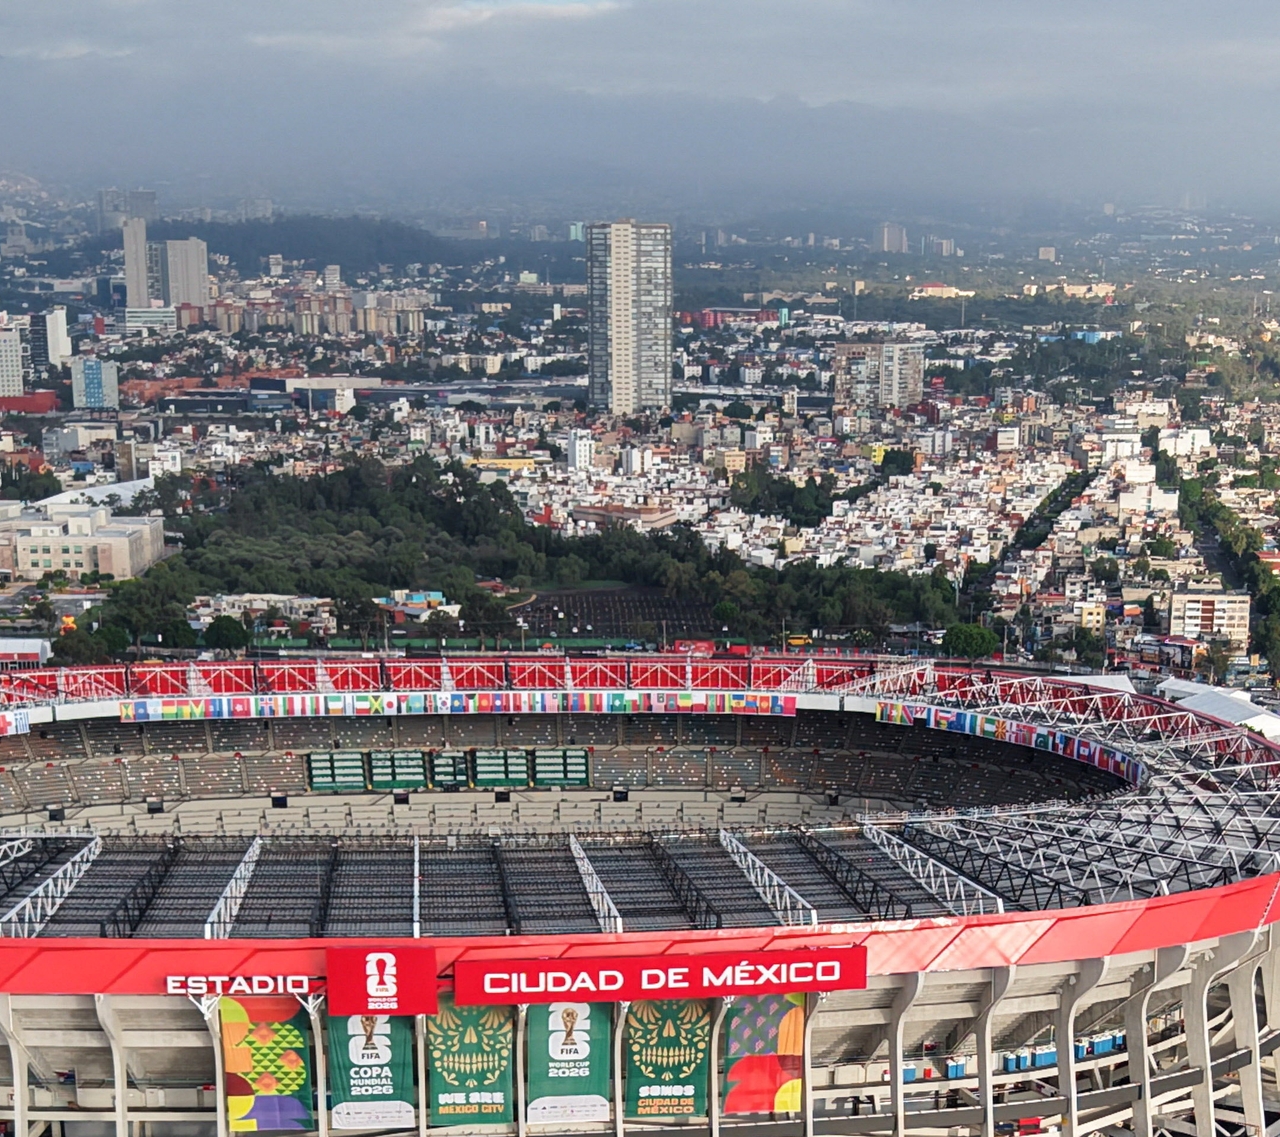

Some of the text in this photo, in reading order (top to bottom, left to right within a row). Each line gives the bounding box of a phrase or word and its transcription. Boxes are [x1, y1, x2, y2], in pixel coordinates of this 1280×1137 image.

[484, 959, 840, 994] CIUDAD DE MÉXICO
[166, 975, 309, 994] ESTADIO
[367, 1002, 398, 1010] 2026
[361, 1052, 380, 1060] FIFA
[350, 1066, 392, 1078] COPA
[548, 1068, 590, 1077] 2026
[350, 1078, 394, 1086] MUNDIAL
[350, 1086, 394, 1096] 2026
[638, 1098, 678, 1106] CIUDAD
[481, 1104, 504, 1113] CITY
